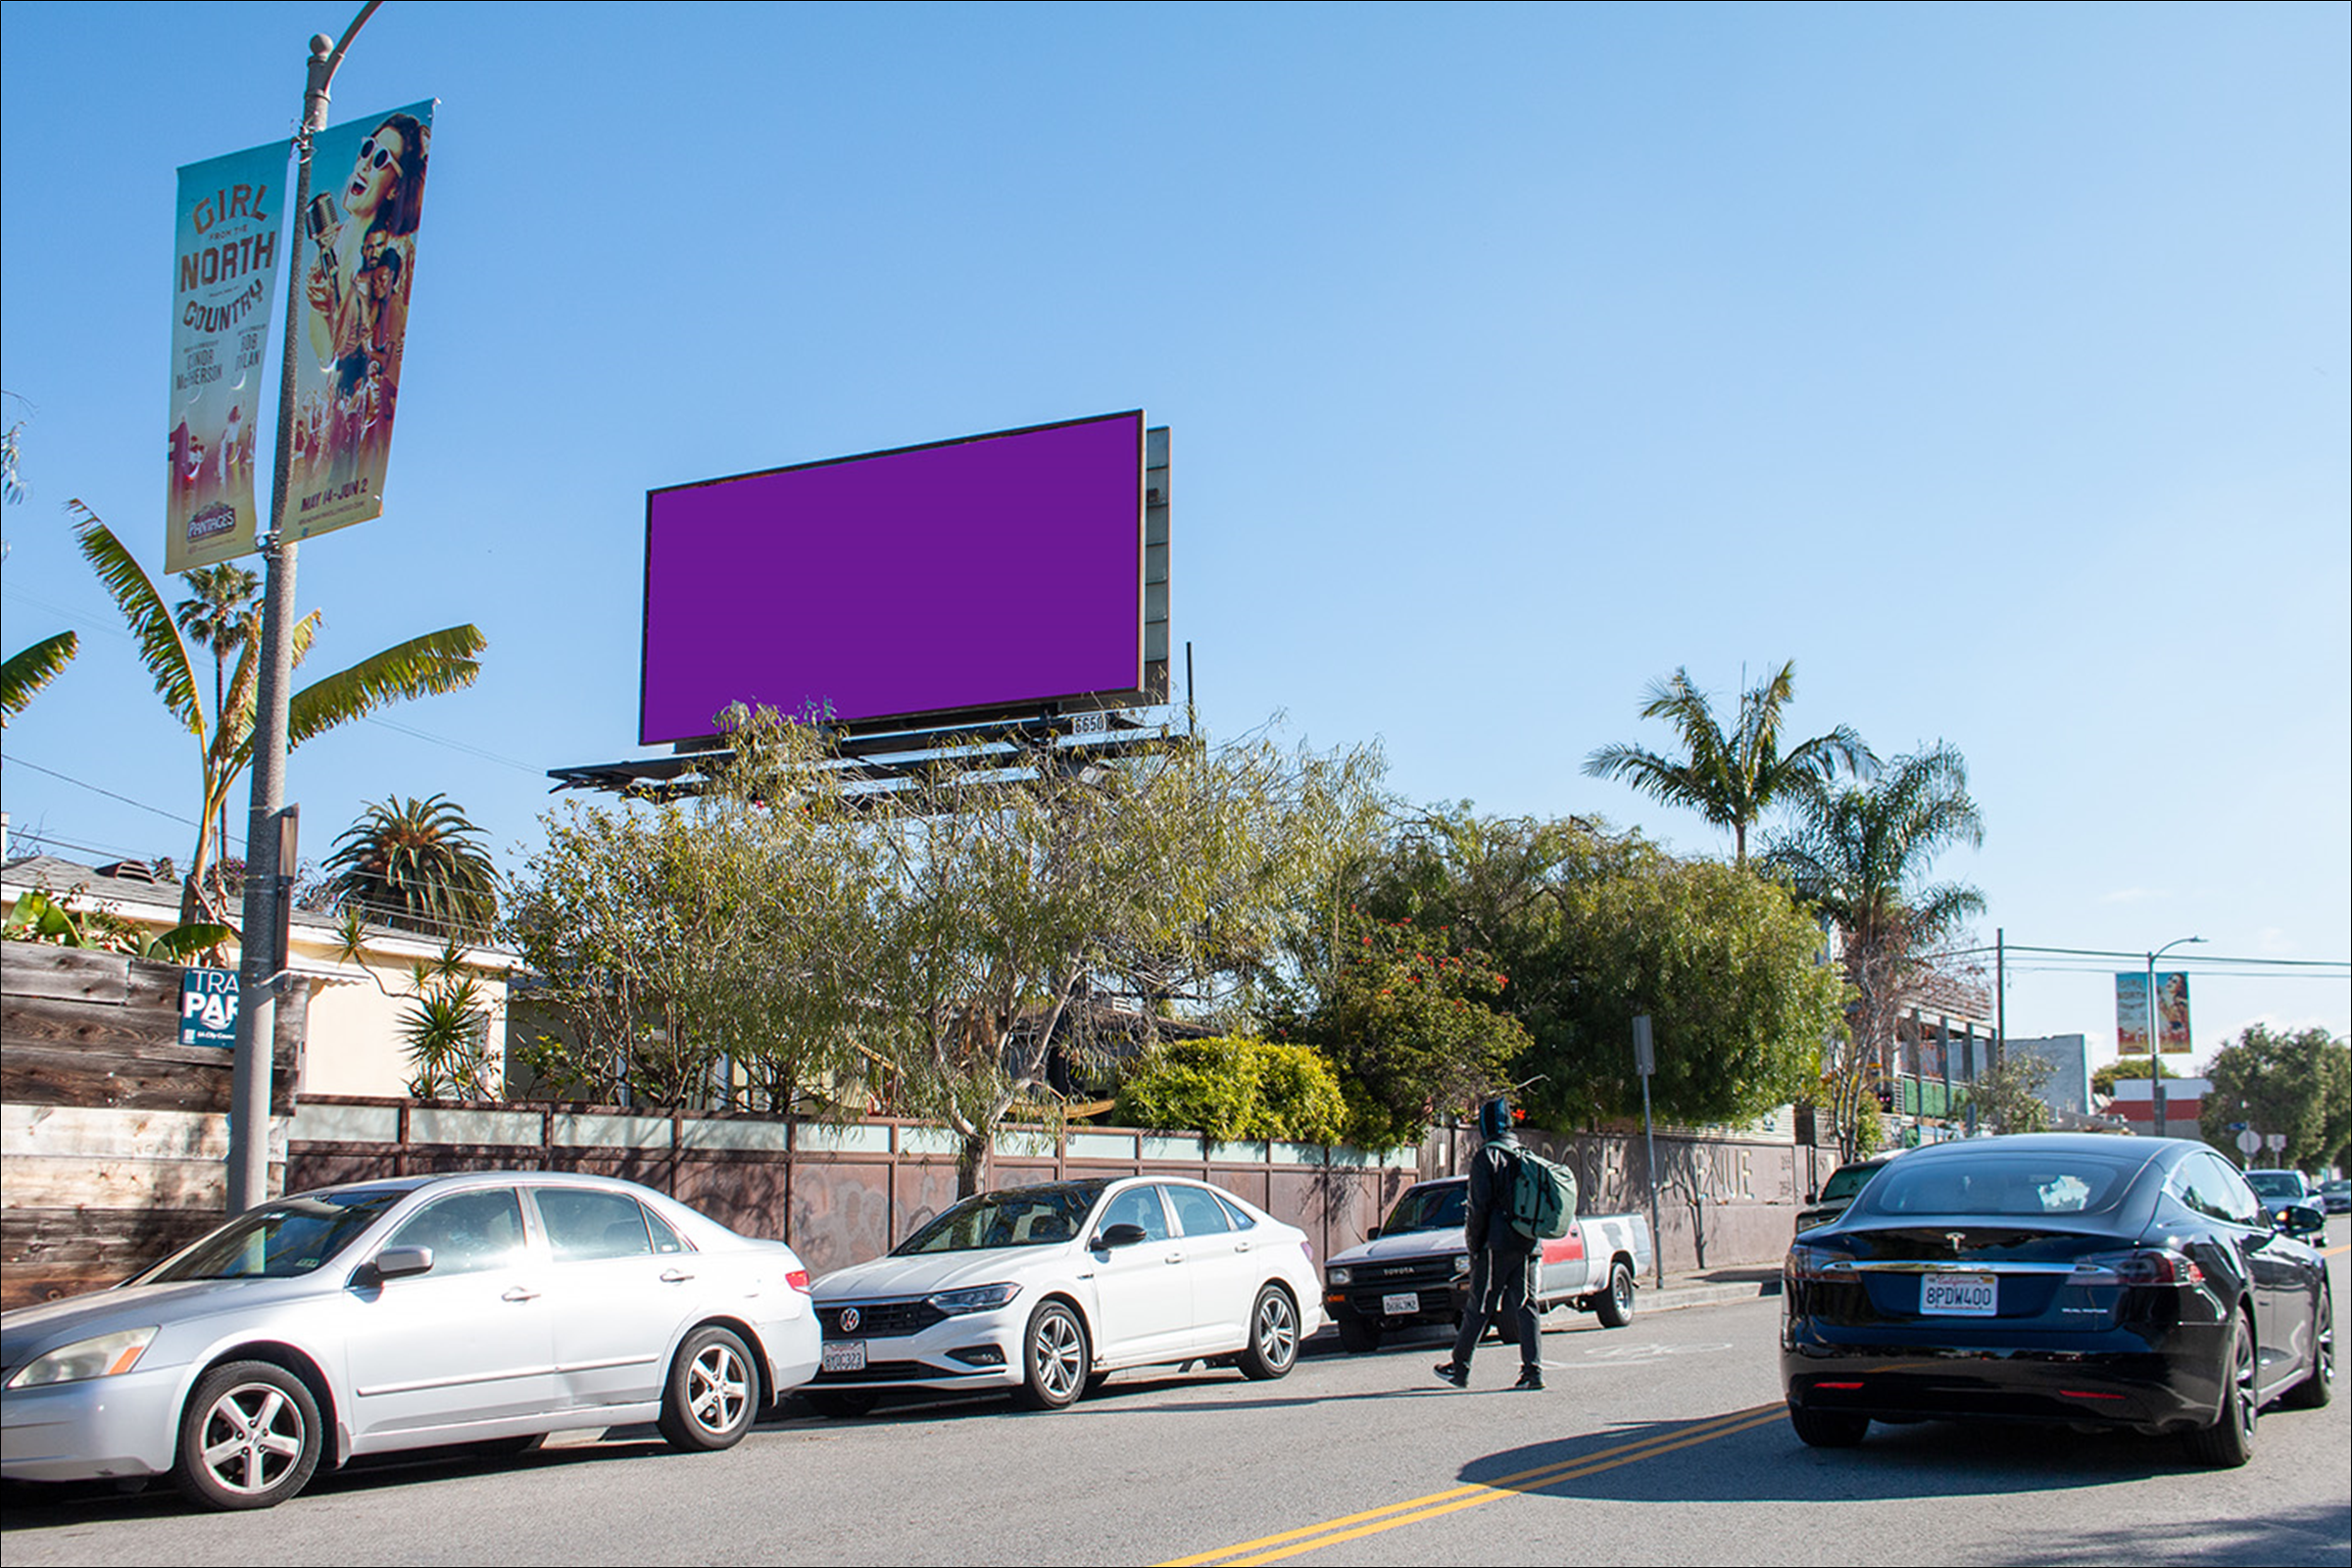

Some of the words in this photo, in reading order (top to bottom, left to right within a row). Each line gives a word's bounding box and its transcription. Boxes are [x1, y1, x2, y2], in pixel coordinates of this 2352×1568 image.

[192, 183, 268, 235] GIRL
[180, 230, 276, 293] NORTH
[182, 278, 264, 333] COUNTRY
[300, 491, 322, 513] MAY
[360, 477, 368, 494] 2
[188, 511, 235, 538] PANTAGES
[1075, 715, 1104, 733] 6650
[191, 969, 240, 994] TRA
[1384, 1266, 1415, 1276] TOYOTA
[1926, 1287, 1992, 1305] 8PDW400
